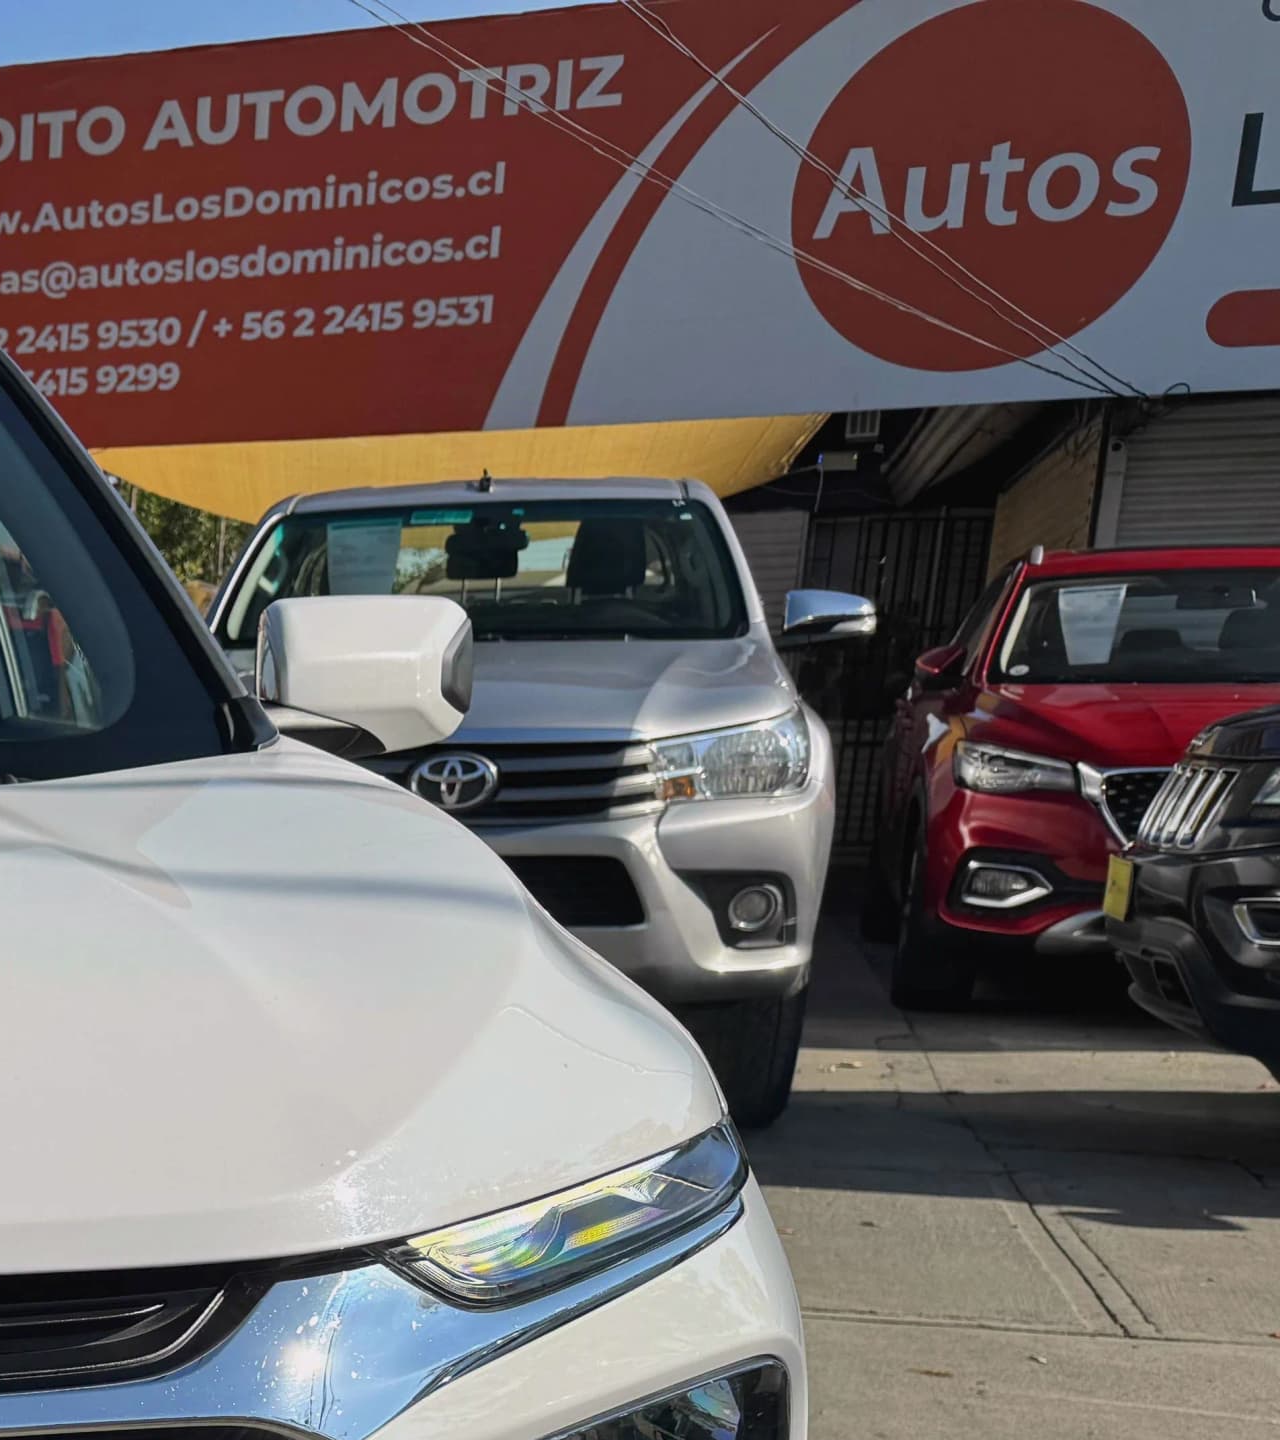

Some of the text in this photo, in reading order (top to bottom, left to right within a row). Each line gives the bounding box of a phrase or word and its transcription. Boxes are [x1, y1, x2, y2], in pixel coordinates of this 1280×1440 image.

[143, 53, 625, 151] AUTOMOTRIZ
[812, 140, 1162, 240] Autos
[16, 322, 90, 354] 2415
[96, 316, 182, 350] 9530
[240, 309, 287, 341] 56
[293, 307, 316, 337] 2
[322, 301, 405, 335] 2415
[411, 294, 495, 329] 9531
[95, 362, 181, 394] 9299
